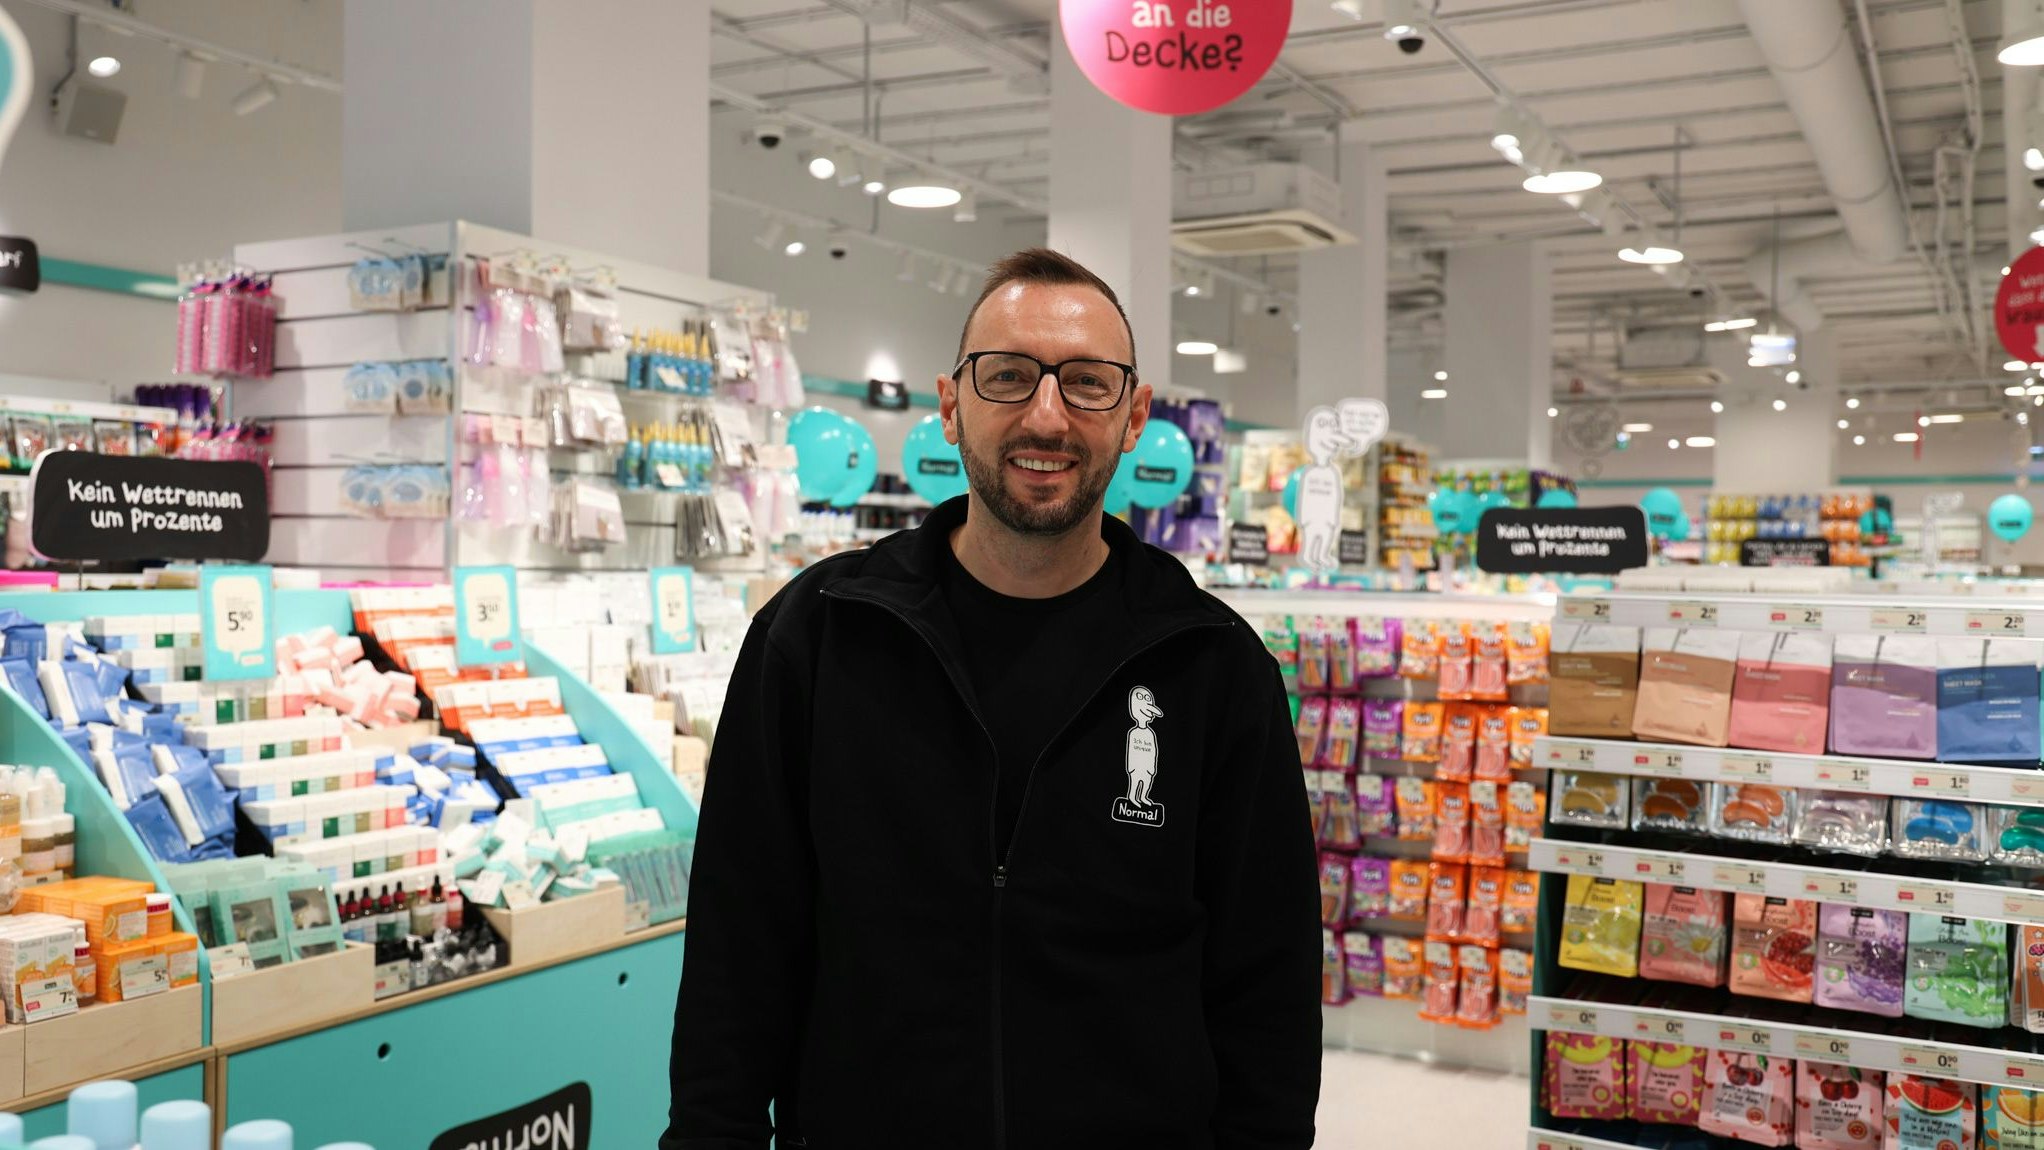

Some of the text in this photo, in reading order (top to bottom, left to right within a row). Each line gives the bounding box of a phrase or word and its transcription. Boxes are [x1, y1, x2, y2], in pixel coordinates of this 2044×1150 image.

[1132, 0, 1232, 28] an die
[1105, 31, 1243, 72] Decke?
[67, 478, 243, 509] Kein Wettrennen
[91, 507, 223, 533] um Prozente
[1496, 523, 1627, 540] Kein Wettrennen
[1510, 540, 1611, 558] um Prozente
[1118, 802, 1158, 821] Normal
[1938, 1055, 1958, 1067] 0.90
[458, 1103, 575, 1150] Norm
